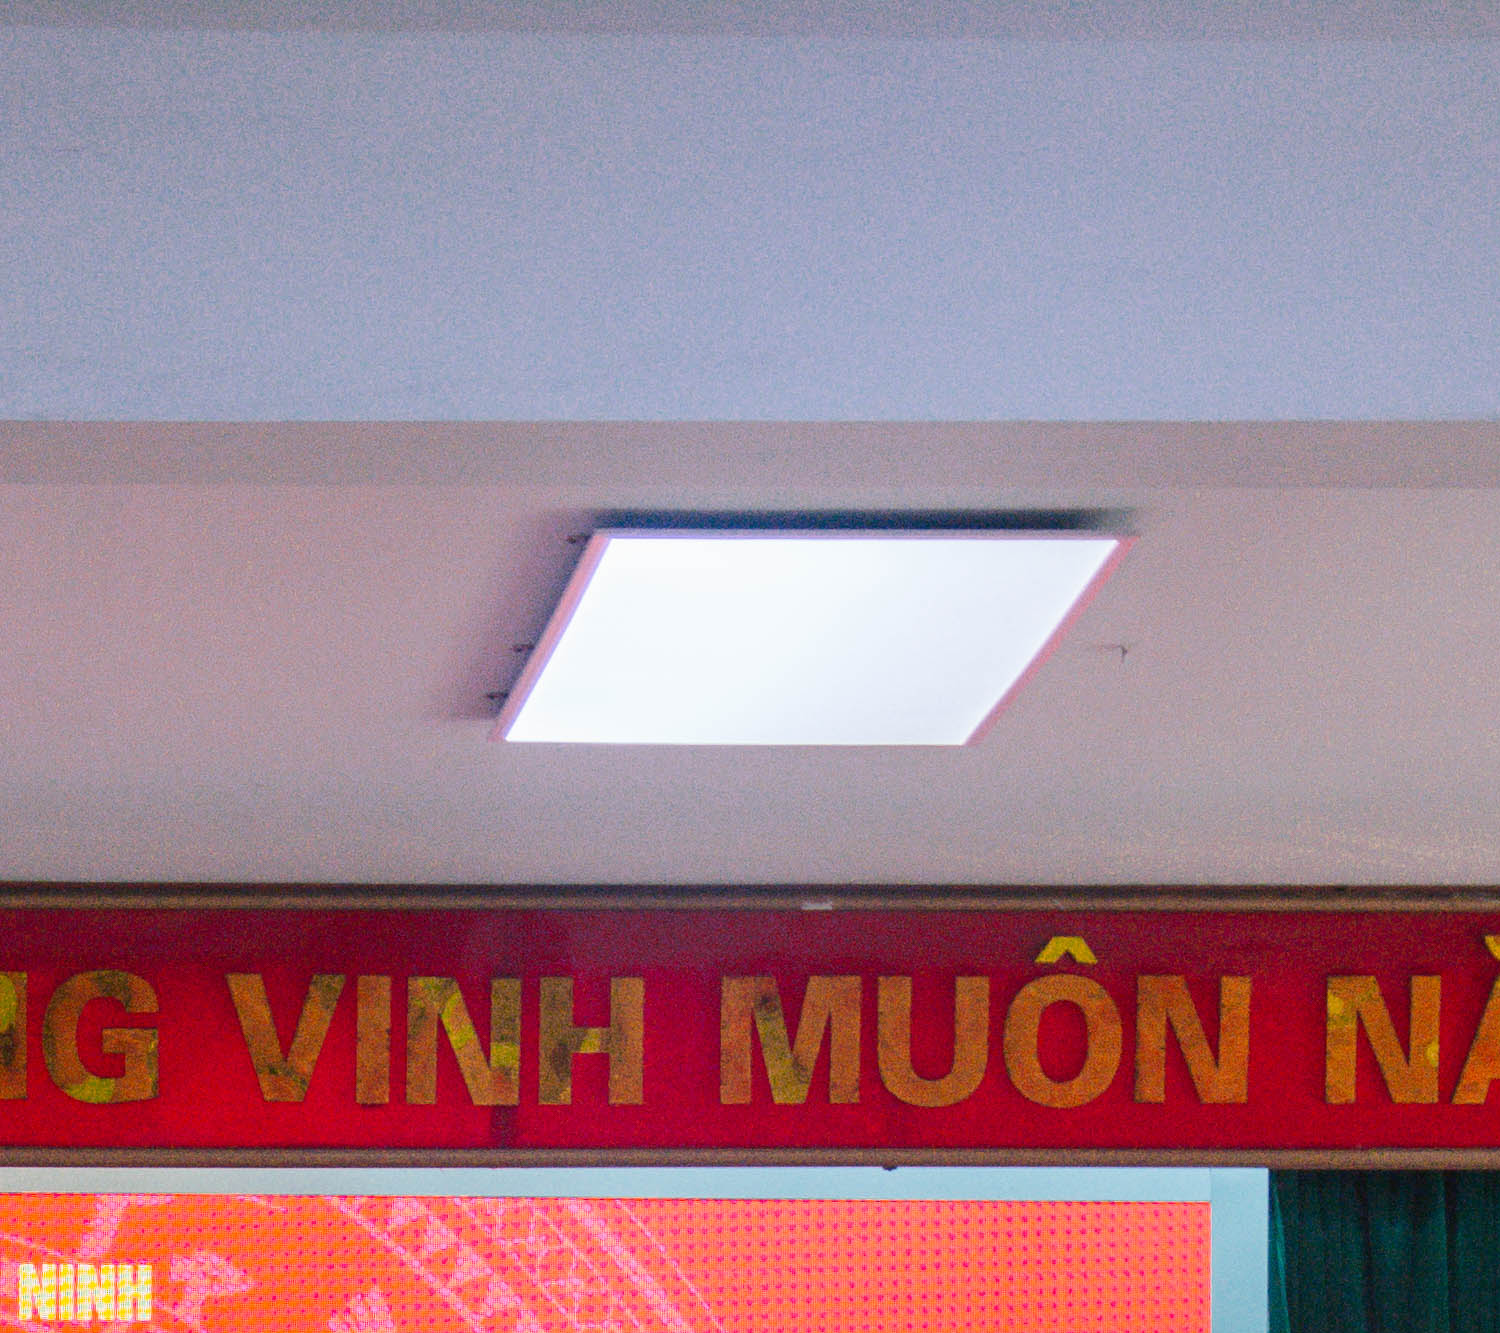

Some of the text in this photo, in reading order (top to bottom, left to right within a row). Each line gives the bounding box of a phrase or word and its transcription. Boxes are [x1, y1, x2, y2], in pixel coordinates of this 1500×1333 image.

[225, 972, 645, 1107] VINH
[719, 935, 1251, 1109] MUÔN
[19, 1264, 151, 1320] NINH
